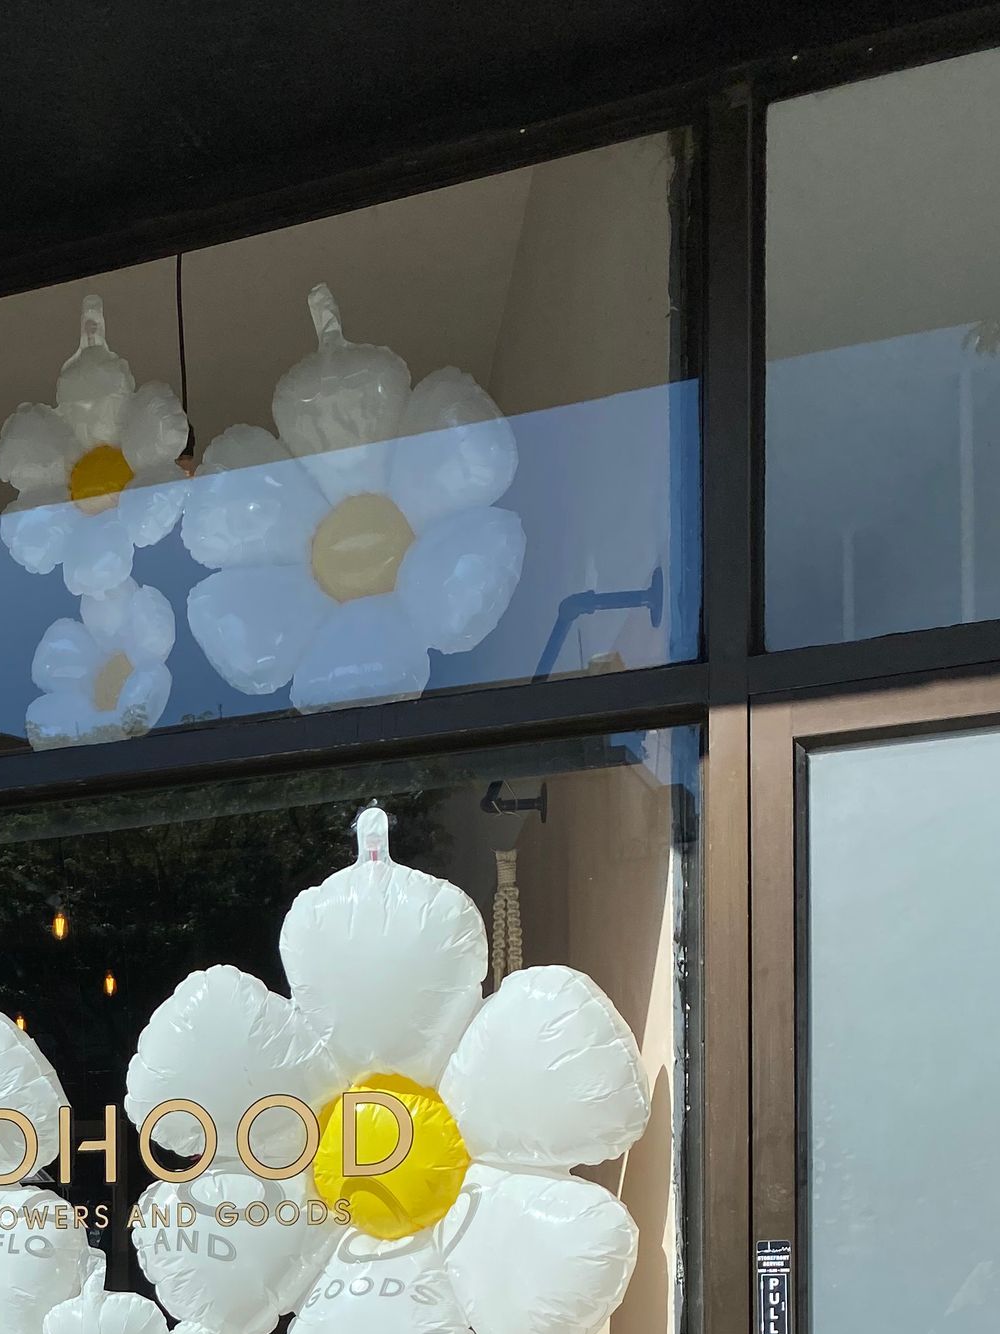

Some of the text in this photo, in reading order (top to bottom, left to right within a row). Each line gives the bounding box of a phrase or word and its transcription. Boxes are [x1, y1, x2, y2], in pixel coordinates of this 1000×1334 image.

[127, 1201, 197, 1228] AND
[214, 1199, 351, 1227] GOODS
[768, 1277, 780, 1334] PULL
